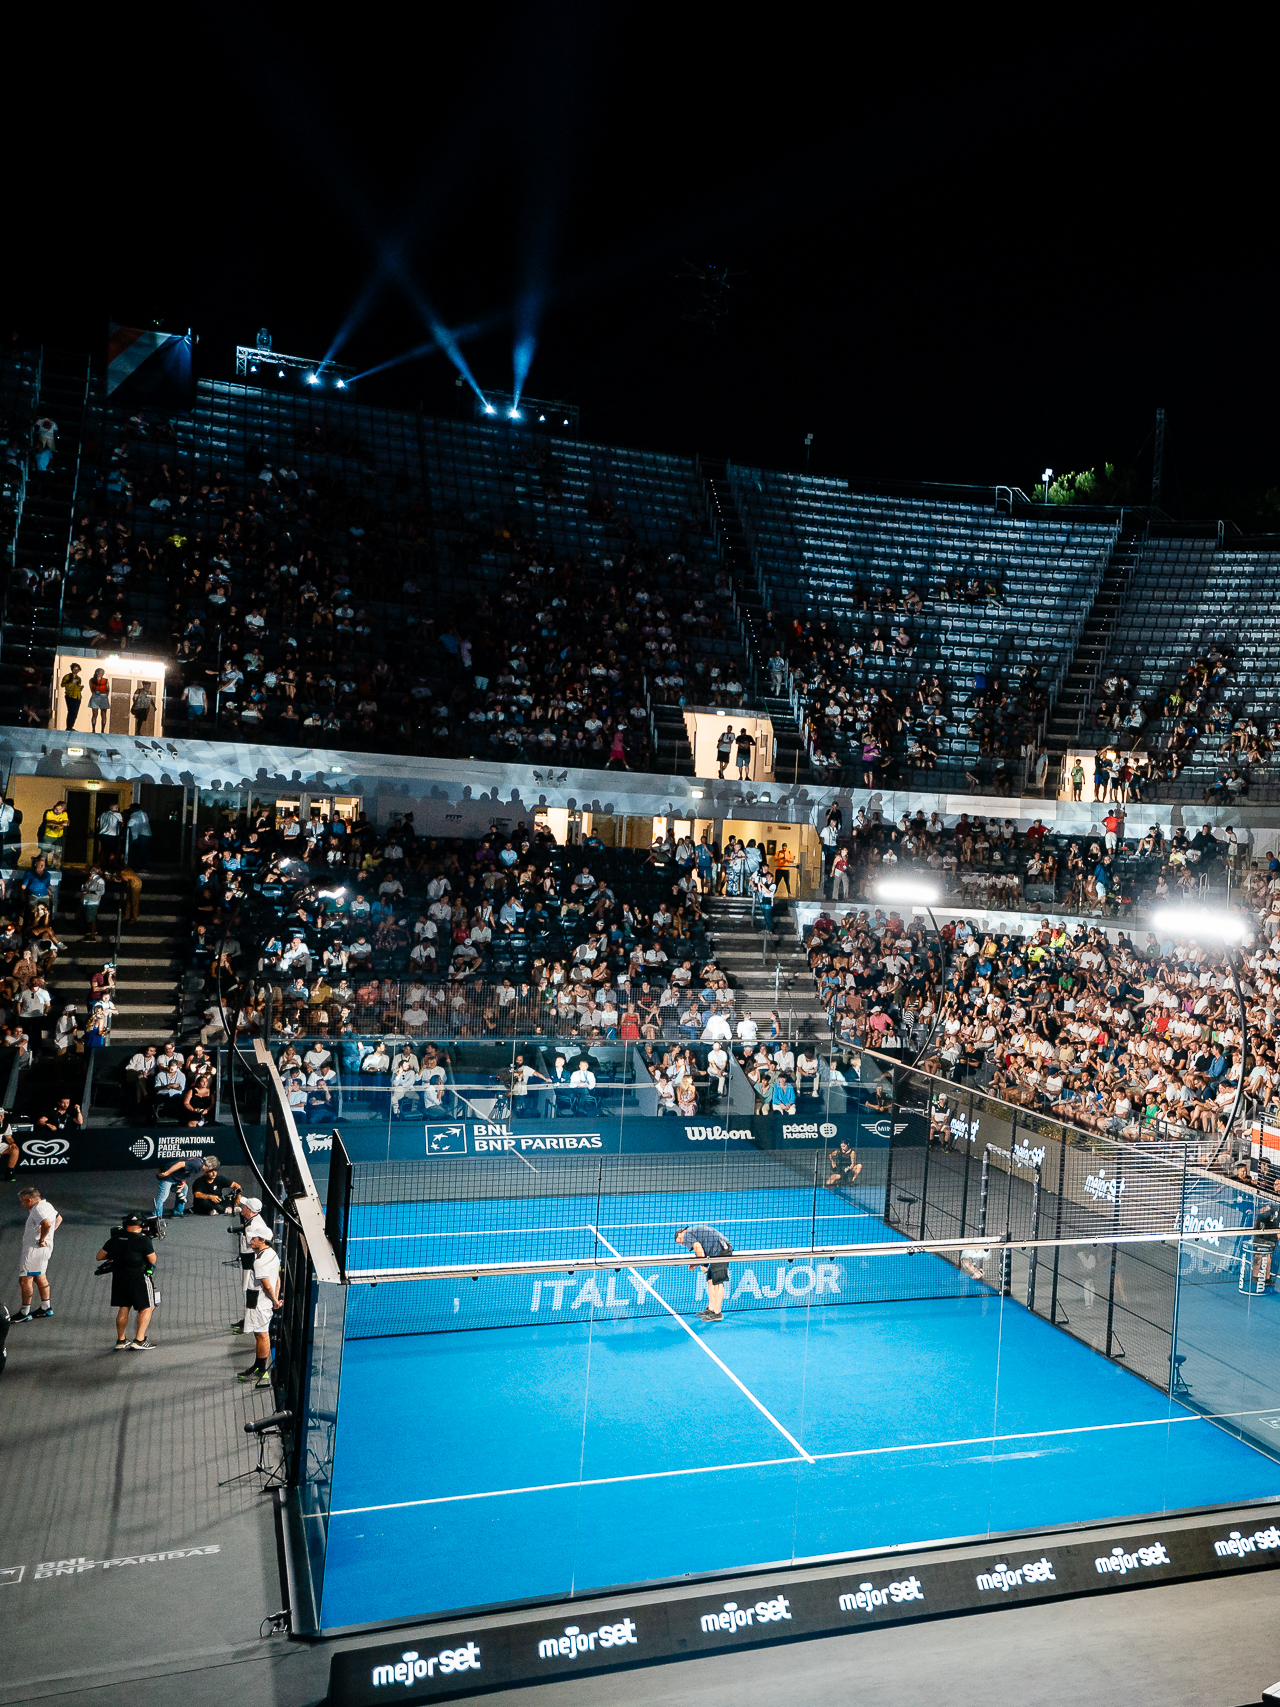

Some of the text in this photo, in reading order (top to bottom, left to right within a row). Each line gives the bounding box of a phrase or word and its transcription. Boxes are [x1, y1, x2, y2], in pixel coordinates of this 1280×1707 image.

[158, 1136, 215, 1144] INTERNATIONAL
[473, 1124, 514, 1136] BNL
[474, 1136, 603, 1151] BNP PARIBAS
[684, 1126, 755, 1141] Wilson
[19, 1157, 68, 1166] ALGIDA
[157, 1150, 203, 1158] FEDERATION
[530, 1273, 660, 1313] ITALY
[976, 1557, 1056, 1592] mejorset
[1094, 1541, 1171, 1575] mejorset
[838, 1576, 925, 1613] mejorset
[700, 1594, 793, 1634] mejorset
[538, 1617, 638, 1660] mejorset
[372, 1641, 481, 1687] mejorset
